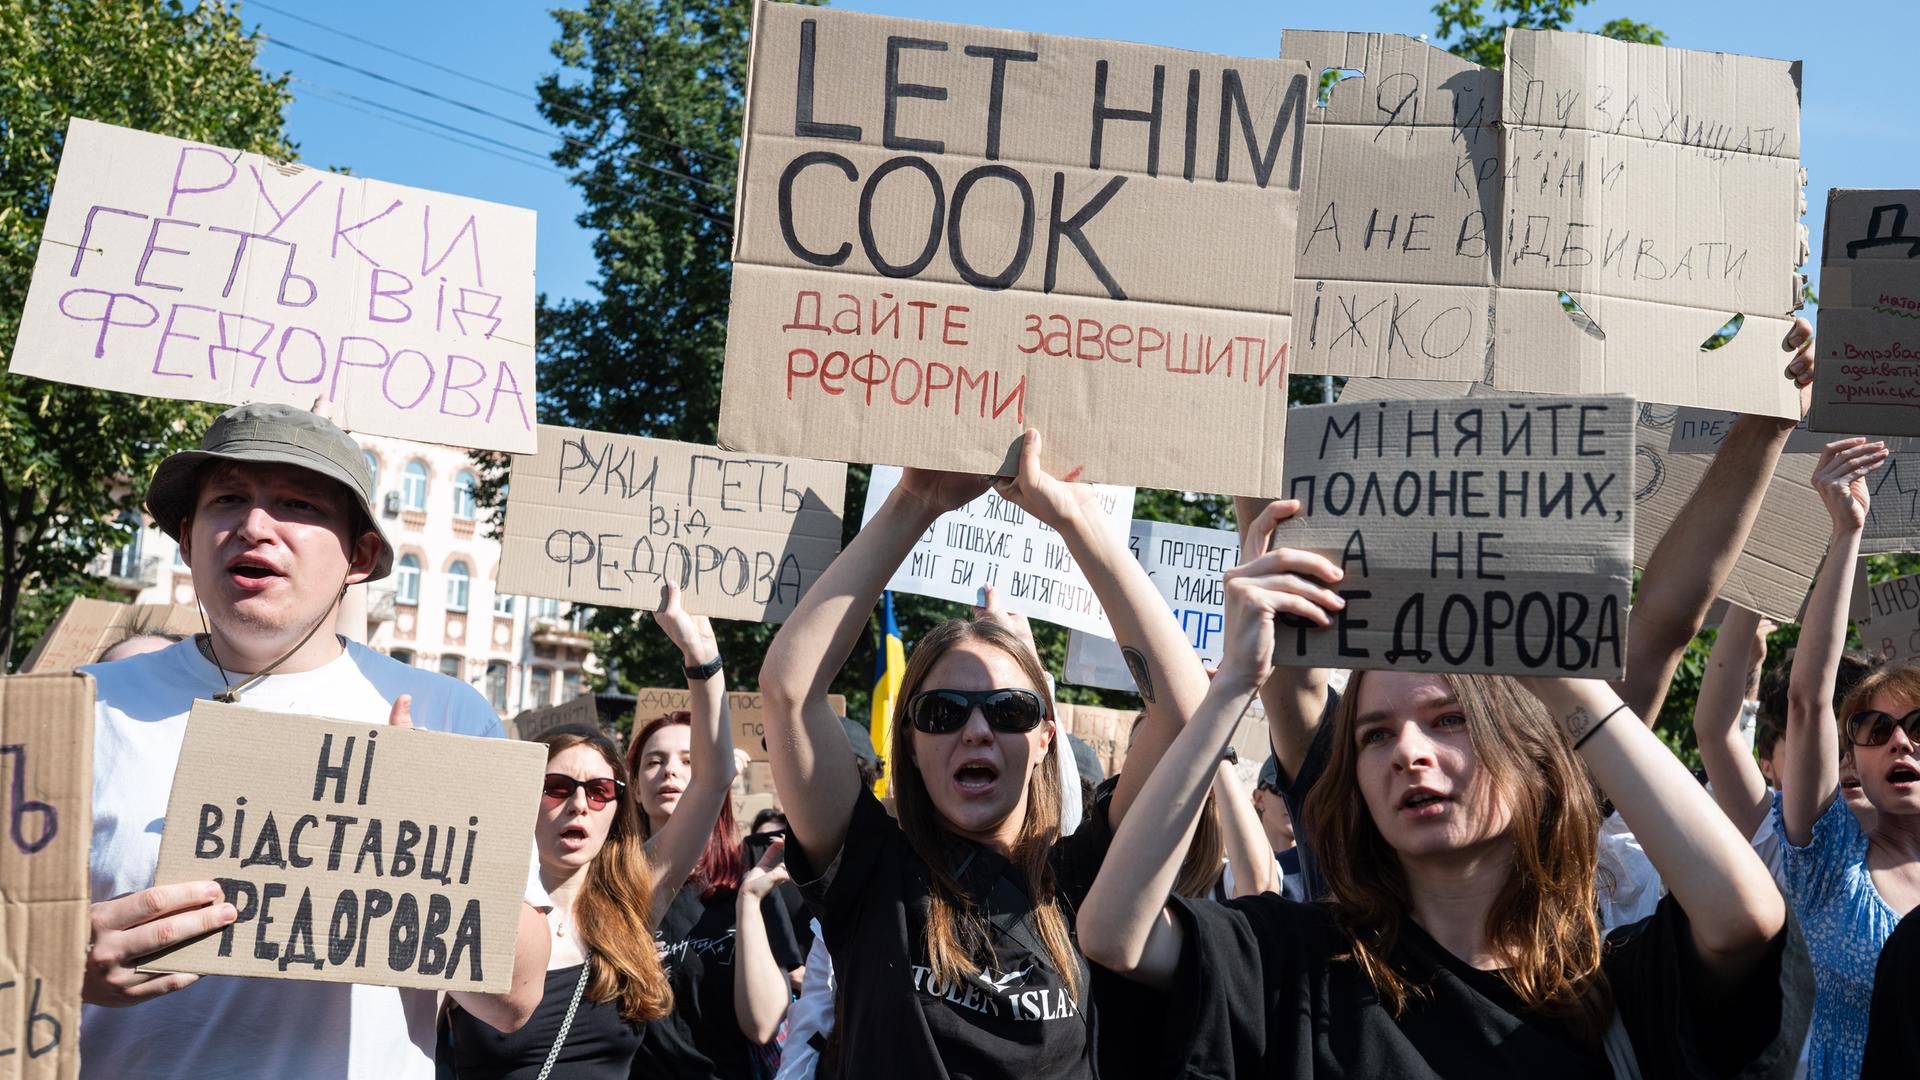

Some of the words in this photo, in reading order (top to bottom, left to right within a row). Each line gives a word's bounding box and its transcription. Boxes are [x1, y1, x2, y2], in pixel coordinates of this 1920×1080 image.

[795, 19, 1038, 160] LET
[1089, 59, 1307, 191] HIM
[1374, 72, 1418, 143] Я
[1591, 85, 1786, 168] ЗАХИЩАТИ
[167, 146, 484, 287] РУКИ
[778, 151, 1128, 300] COOK
[1303, 202, 1341, 255] А
[1363, 208, 1435, 253] НЕ
[70, 205, 318, 307] ГЕТЬ
[1879, 293, 1920, 311] нато
[59, 288, 531, 431] ФЕДОРОВА
[1841, 362, 1920, 381] адекватн
[1836, 381, 1920, 401] армійськ
[558, 435, 658, 503] РУКИ
[689, 455, 804, 513] ГЕТЬ
[1290, 470, 1624, 523] ПОЛОНЕНИХ,
[545, 529, 801, 607] ФЕДОРОВА
[946, 520, 1014, 559] ШТОВХАЄ
[1023, 537, 1034, 564] В
[1160, 539, 1240, 573] ПРОФЕСІ
[1341, 529, 1368, 578] А
[1430, 531, 1506, 581] НЕ
[951, 559, 975, 587] БИ
[1175, 573, 1224, 606] МАЙБ
[911, 964, 999, 1017] TOLEN
